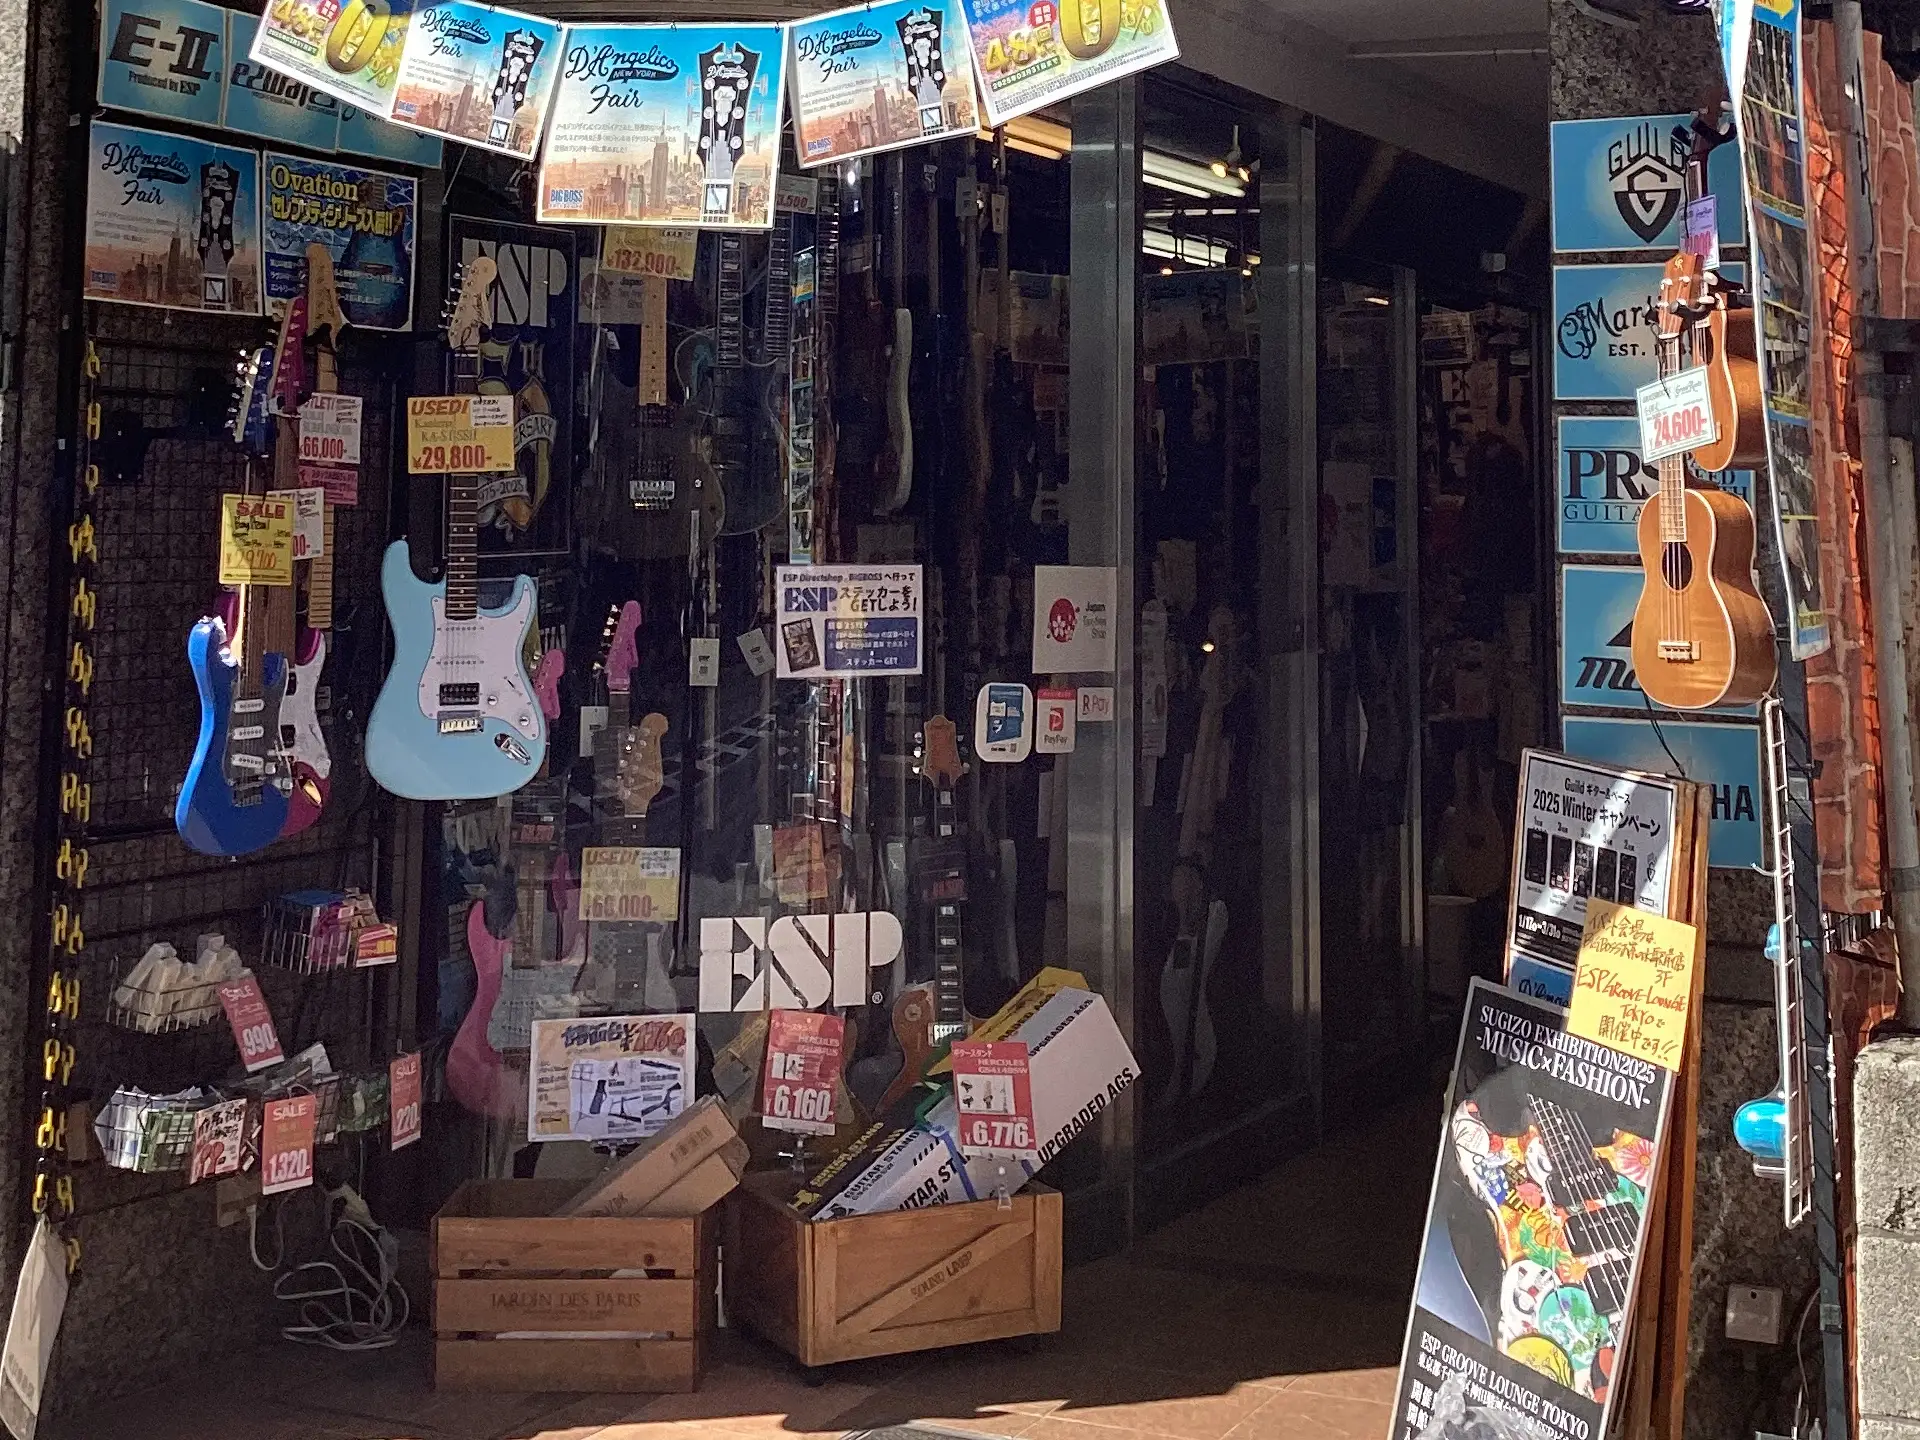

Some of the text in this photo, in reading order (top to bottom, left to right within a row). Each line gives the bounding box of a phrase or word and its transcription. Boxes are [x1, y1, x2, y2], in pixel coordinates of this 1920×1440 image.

[420, 8, 491, 39] D'Angelico
[428, 37, 463, 58] Fair
[798, 22, 882, 61] D'Angelico
[565, 44, 679, 82] D'Angelico
[613, 69, 657, 79] NEW YORK
[820, 57, 860, 83] Fair
[128, 70, 201, 96] Produced by ESP
[587, 83, 644, 114] Fair
[101, 142, 191, 176] D'Angelico
[121, 179, 165, 206] Fair
[270, 164, 359, 201] Ovation
[550, 189, 583, 202] BIG BOSS
[1608, 343, 1646, 357] EST.
[412, 445, 492, 471] ¥29,800-
[236, 502, 286, 520] SALE
[884, 572, 916, 582] へ行って
[840, 585, 913, 599] ステッカーを
[850, 597, 917, 612] GETしよう!
[1085, 601, 1106, 612] Japan
[1043, 733, 1069, 745] PayPay
[1564, 777, 1585, 795] Guild
[1532, 788, 1560, 814] 2025
[1562, 794, 1598, 823] Winter
[1599, 805, 1661, 837] キャンペーン
[699, 910, 903, 1013] ESP
[1576, 963, 1611, 993] ESP
[1654, 969, 1674, 988] 3F
[1479, 1004, 1532, 1039] SUGIZO
[1028, 1014, 1075, 1057] UPGRADED
[978, 1058, 1025, 1067] HERCULES
[272, 1102, 308, 1121] SALE
[1037, 1066, 1135, 1164] UPGRADED AGS
[964, 1120, 1035, 1148] ¥6,776-
[843, 1163, 884, 1199] GUITAR
[883, 1130, 920, 1166] STAND
[559, 1292, 589, 1308] DES
[595, 1291, 641, 1309] PARIS
[1420, 1331, 1590, 1439] ESP GROOVE LOUNGE TOKYO
